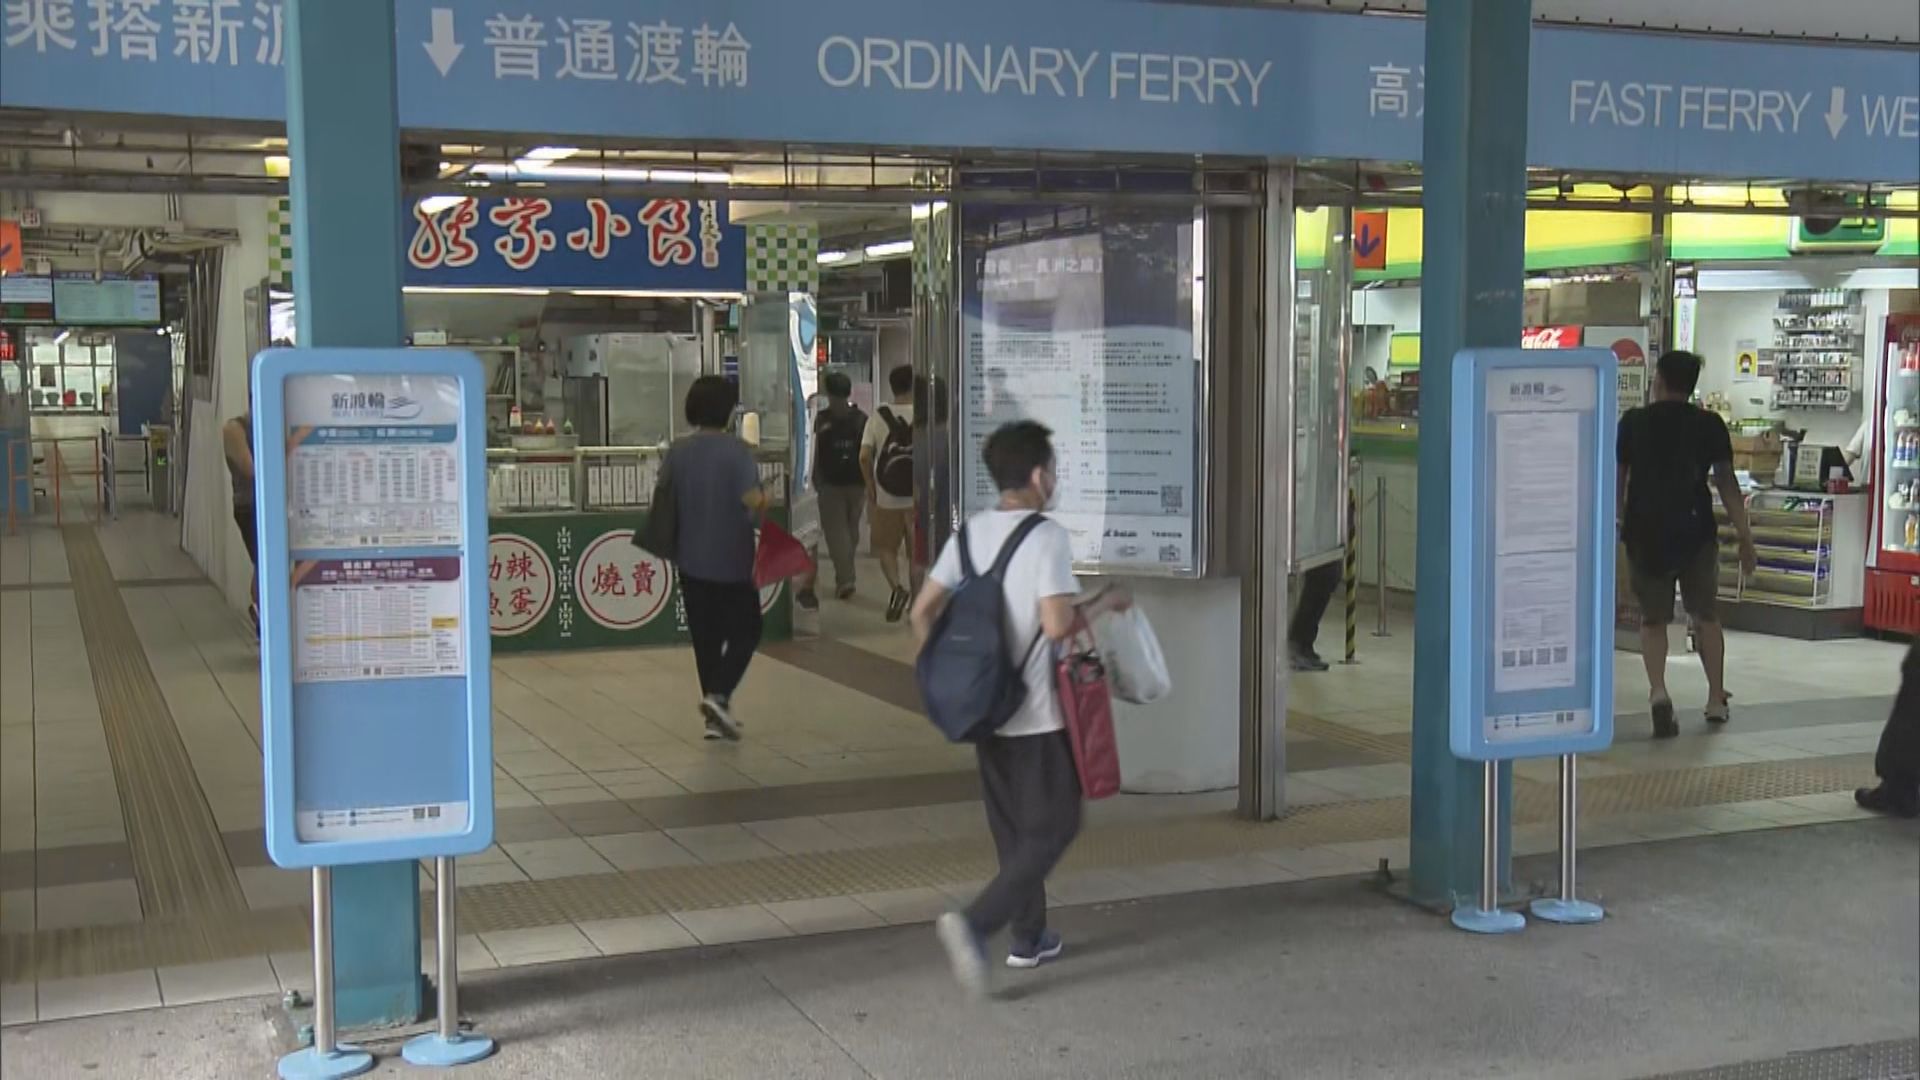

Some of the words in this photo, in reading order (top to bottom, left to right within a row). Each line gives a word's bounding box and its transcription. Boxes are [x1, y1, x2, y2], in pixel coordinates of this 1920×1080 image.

[483, 12, 752, 88] 普通渡輪
[817, 35, 1099, 98] ORDINARY
[1109, 50, 1272, 107] FERRY
[1368, 62, 1425, 120] 高
[1569, 79, 1673, 128] FAST
[1679, 85, 1812, 134] FERRY
[1861, 94, 1919, 138] WE
[591, 562, 657, 597] 燒賣
